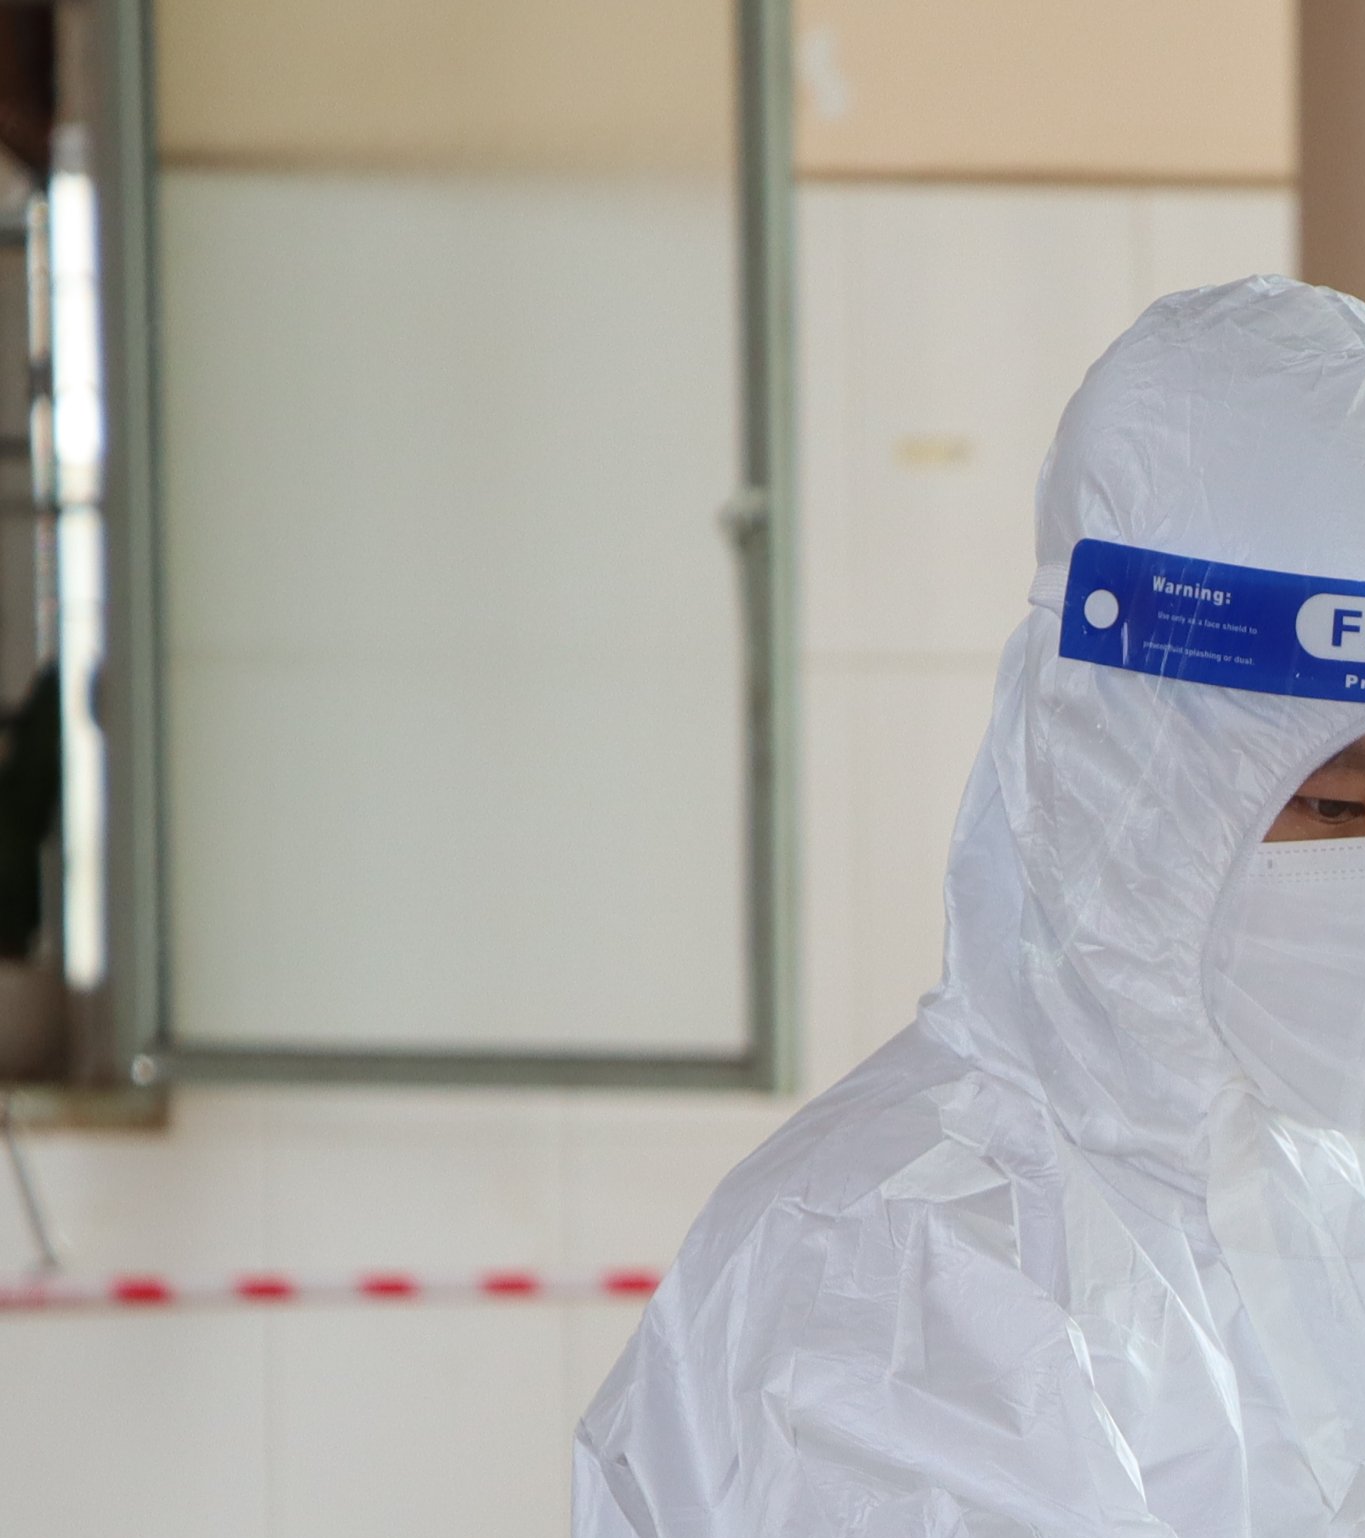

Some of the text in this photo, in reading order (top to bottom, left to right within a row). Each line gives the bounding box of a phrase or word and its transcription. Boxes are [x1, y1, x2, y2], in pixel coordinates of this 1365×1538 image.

[1152, 575, 1231, 606] Warning:
[1204, 618, 1220, 629] face
[1222, 622, 1247, 633] shield
[1249, 626, 1258, 635] to
[1184, 646, 1222, 662] splashing
[1223, 654, 1232, 662] or
